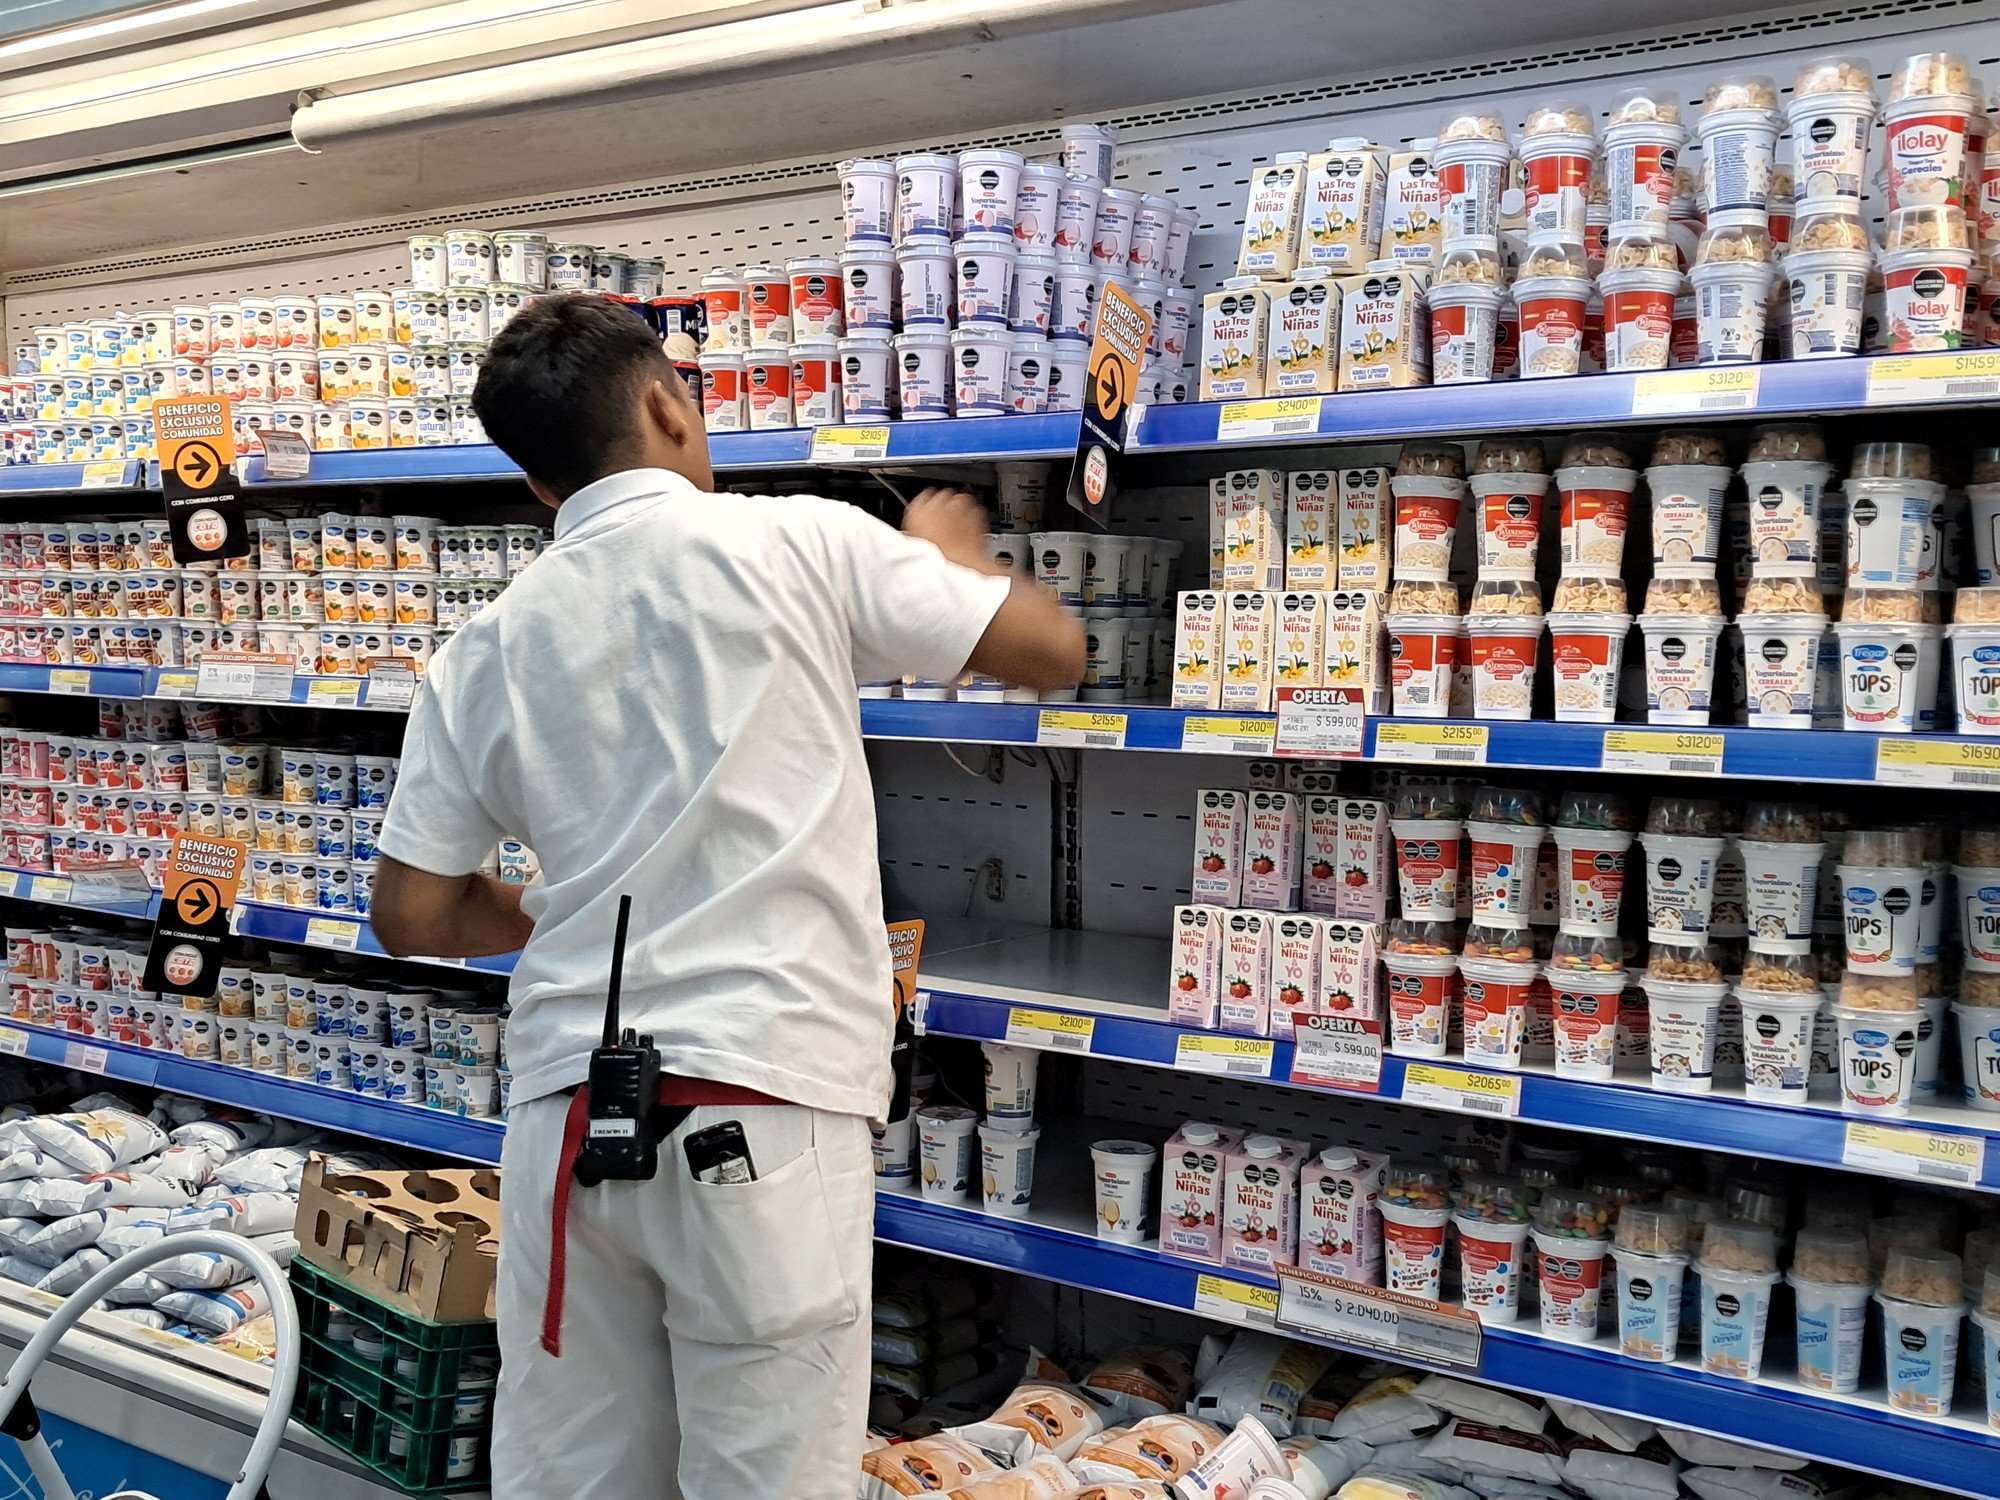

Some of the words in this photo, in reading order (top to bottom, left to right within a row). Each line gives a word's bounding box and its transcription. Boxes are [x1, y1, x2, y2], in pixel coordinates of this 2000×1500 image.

[1898, 131, 1948, 152] ilolay
[1901, 164, 1942, 175] Cereales
[1318, 180, 1337, 190] Las
[1338, 178, 1356, 189] Tres
[1400, 180, 1419, 190] Las
[1420, 179, 1441, 189] Tres
[1318, 189, 1354, 203] Niñas
[1400, 189, 1438, 203] Niñas
[1105, 291, 1146, 334] BENEFICIO
[1356, 303, 1373, 312] Las
[1375, 300, 1394, 310] Tres
[1908, 301, 1950, 317] ilolay
[1282, 310, 1299, 319] Las
[1301, 307, 1320, 317] Tres
[1356, 311, 1393, 324] Niñas
[1213, 318, 1230, 328] Las
[1231, 316, 1250, 326] Tres
[1283, 318, 1319, 331] Niñas
[1102, 310, 1141, 350] EXCLUSIVO
[1214, 328, 1249, 341] Niñas
[1100, 324, 1138, 365] COMUNIDAD
[1956, 356, 1995, 370] $1459
[1708, 372, 1743, 386] $3120
[159, 403, 222, 417] BENEFICIO
[1277, 400, 1308, 412] $2400
[160, 415, 222, 429] EXCLUSIVO
[162, 427, 224, 439] COMUNIDAD
[861, 430, 882, 440] $2105
[1310, 495, 1325, 503] Tres
[1346, 493, 1360, 502] Las
[1360, 492, 1375, 501] Tres
[1296, 501, 1324, 512] Niñas
[1347, 499, 1374, 510] Niñas
[1198, 614, 1212, 623] Tres
[1283, 615, 1298, 623] Las
[1298, 614, 1312, 623] Tres
[1333, 614, 1347, 622] Las
[1348, 614, 1362, 622] Tres
[1184, 621, 1210, 632] Niñas
[1284, 621, 1310, 633] Niñas
[1334, 621, 1361, 632] Niñas
[1854, 648, 1886, 658] Tregar
[1850, 674, 1892, 692] TOPS
[1970, 676, 2000, 695] TOP
[1292, 690, 1349, 705] OFERTA
[1092, 714, 1116, 726] $2155
[1240, 721, 1267, 732] $1200
[1442, 727, 1472, 740] $2155
[1677, 736, 1712, 750] $3120
[1962, 745, 2000, 760] $1690
[1203, 812, 1216, 821] Las
[1217, 813, 1231, 823] Tres
[1204, 819, 1230, 830] Niñas
[1345, 824, 1358, 832] Las
[1359, 825, 1374, 833] Tres
[1345, 830, 1372, 842] Niñas
[179, 839, 238, 857] BENEFICIO
[177, 851, 235, 869] EXCLUSIVO
[175, 863, 233, 880] COMUNIDAD
[1847, 916, 1882, 935] TOPS
[889, 928, 917, 944] EFICIO
[1180, 936, 1203, 948] Niñas
[1191, 931, 1205, 940] Tres
[1230, 936, 1242, 945] Las
[1243, 937, 1257, 946] Tres
[1230, 942, 1256, 955] Niñas
[1329, 946, 1343, 955] Las
[1344, 948, 1359, 957] Tres
[1329, 953, 1358, 965] Niñas
[1059, 1016, 1083, 1028] $2100
[1307, 1016, 1366, 1035] OFERTA
[1234, 1040, 1262, 1053] $1200
[1344, 1043, 1376, 1057] 599,00
[1850, 1059, 1892, 1078] TOPS
[1467, 1074, 1502, 1090] $2065
[1928, 1138, 1965, 1156] $1378
[1175, 1170, 1192, 1181] Las
[1194, 1172, 1212, 1184] Tres
[1176, 1179, 1210, 1196] Niñas
[1237, 1184, 1253, 1195] Las
[1255, 1186, 1274, 1199] Tres
[1238, 1192, 1272, 1210] Niñas
[1312, 1196, 1328, 1204] Las
[1330, 1197, 1348, 1211] Tres
[1313, 1204, 1347, 1223] Niñas
[1278, 1265, 1324, 1283] BENEFICIO
[1325, 1277, 1376, 1295] EXCLUSIVO
[1378, 1288, 1438, 1311] COMUNIDAD
[1299, 1285, 1322, 1301] 15%
[1335, 1299, 1342, 1313] $
[1346, 1302, 1399, 1325] 2.040,00
